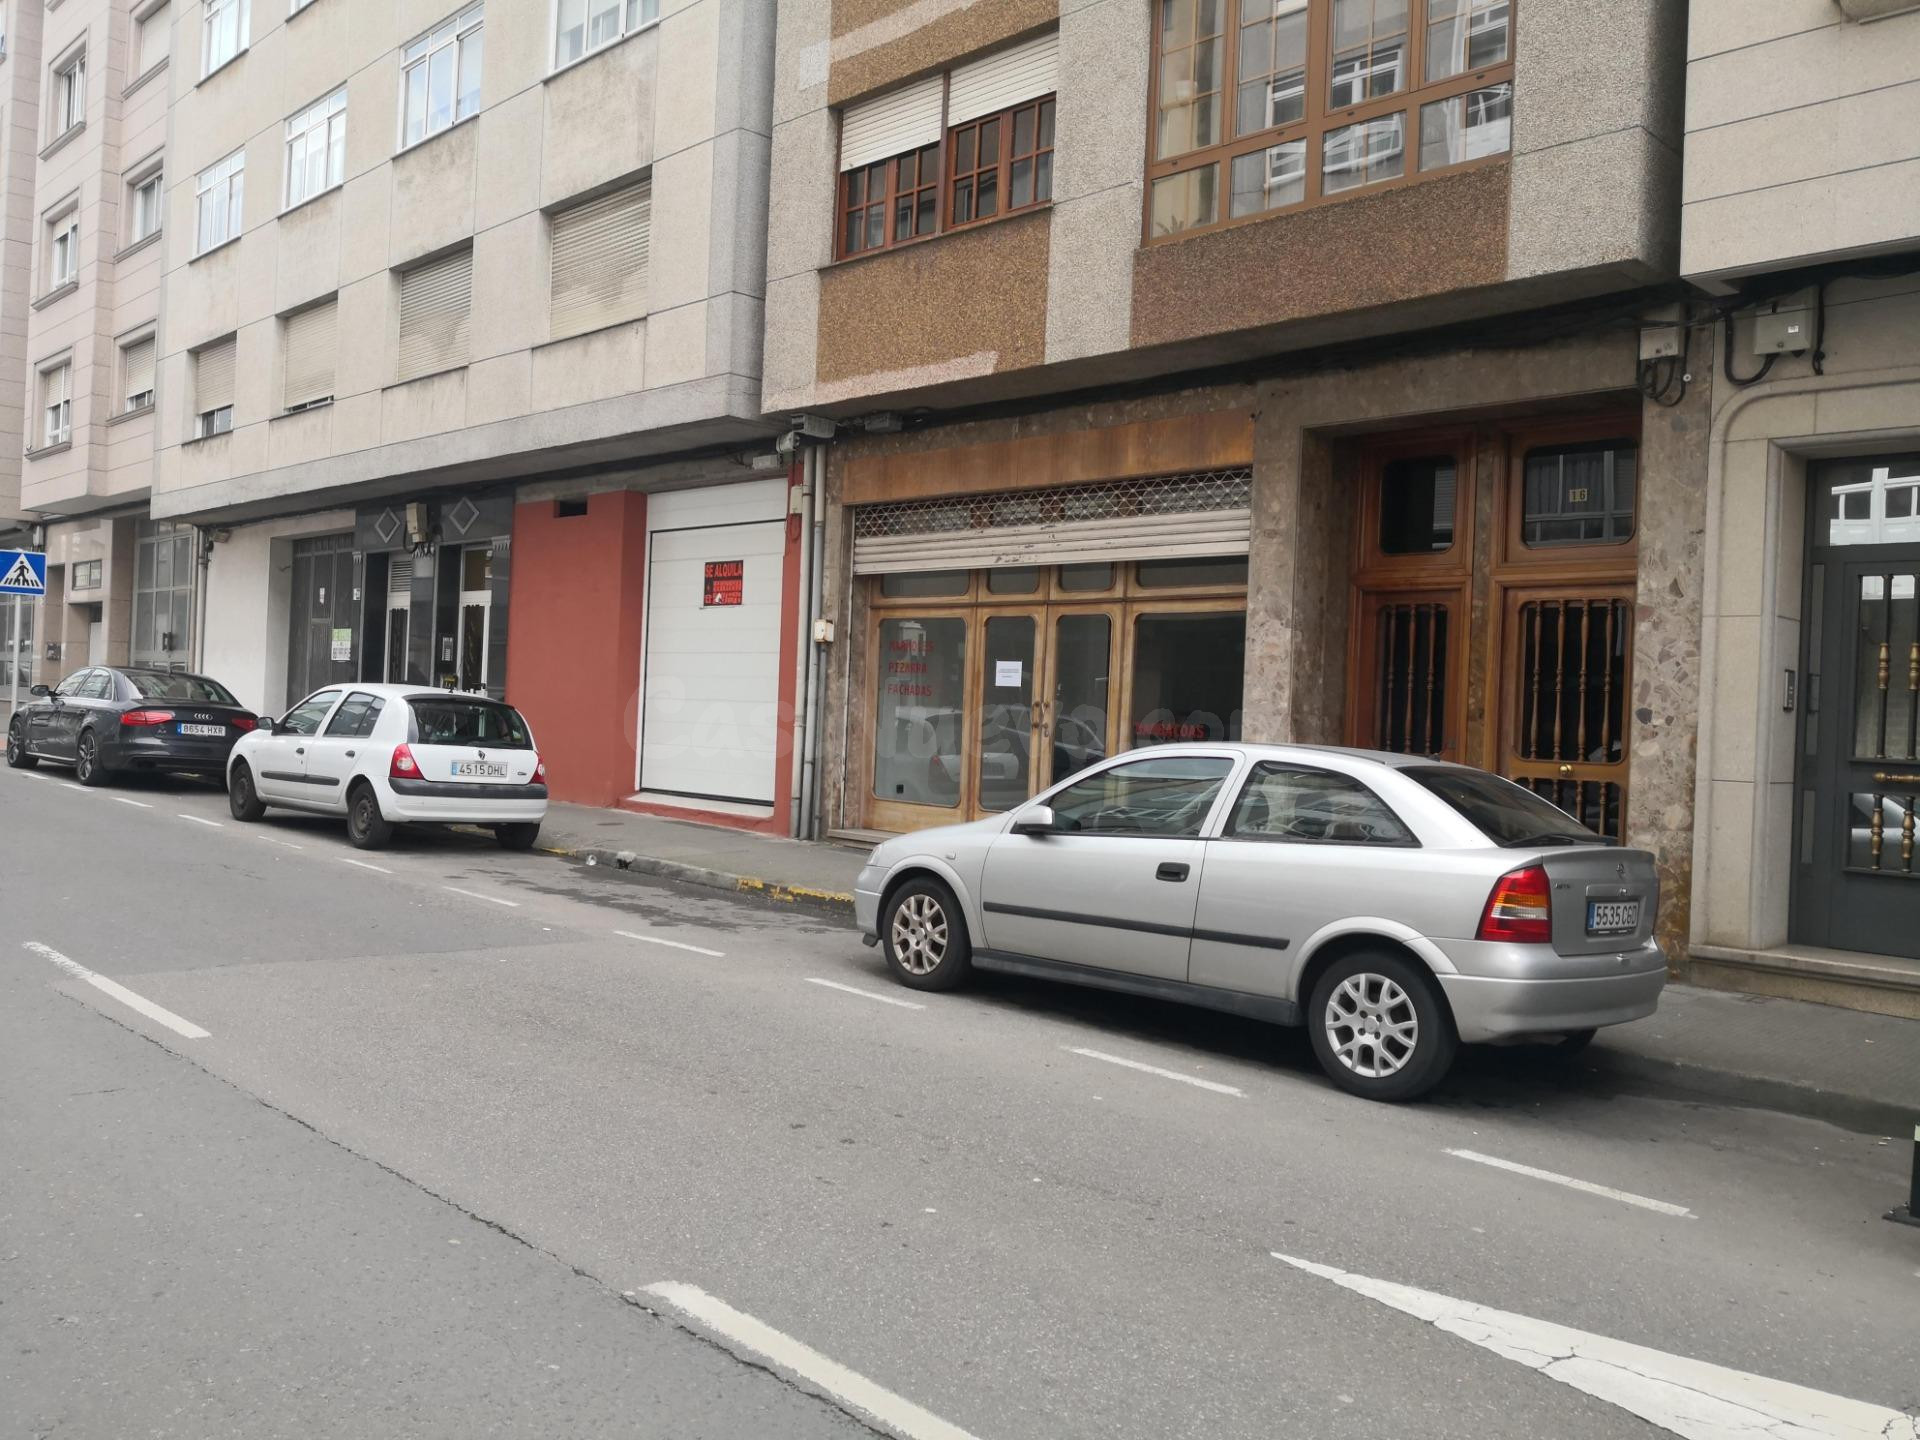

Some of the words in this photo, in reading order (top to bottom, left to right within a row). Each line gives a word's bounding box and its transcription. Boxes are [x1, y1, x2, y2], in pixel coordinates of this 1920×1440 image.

[705, 564, 714, 577] SE
[714, 562, 742, 577] ALQUILA
[888, 662, 928, 672] PIZARRA
[887, 683, 932, 696] FACHADAS
[183, 724, 205, 734] 8654
[207, 726, 224, 735] HXR
[459, 764, 486, 776] 4515
[487, 765, 505, 776] DHL
[1596, 905, 1620, 926] 5535
